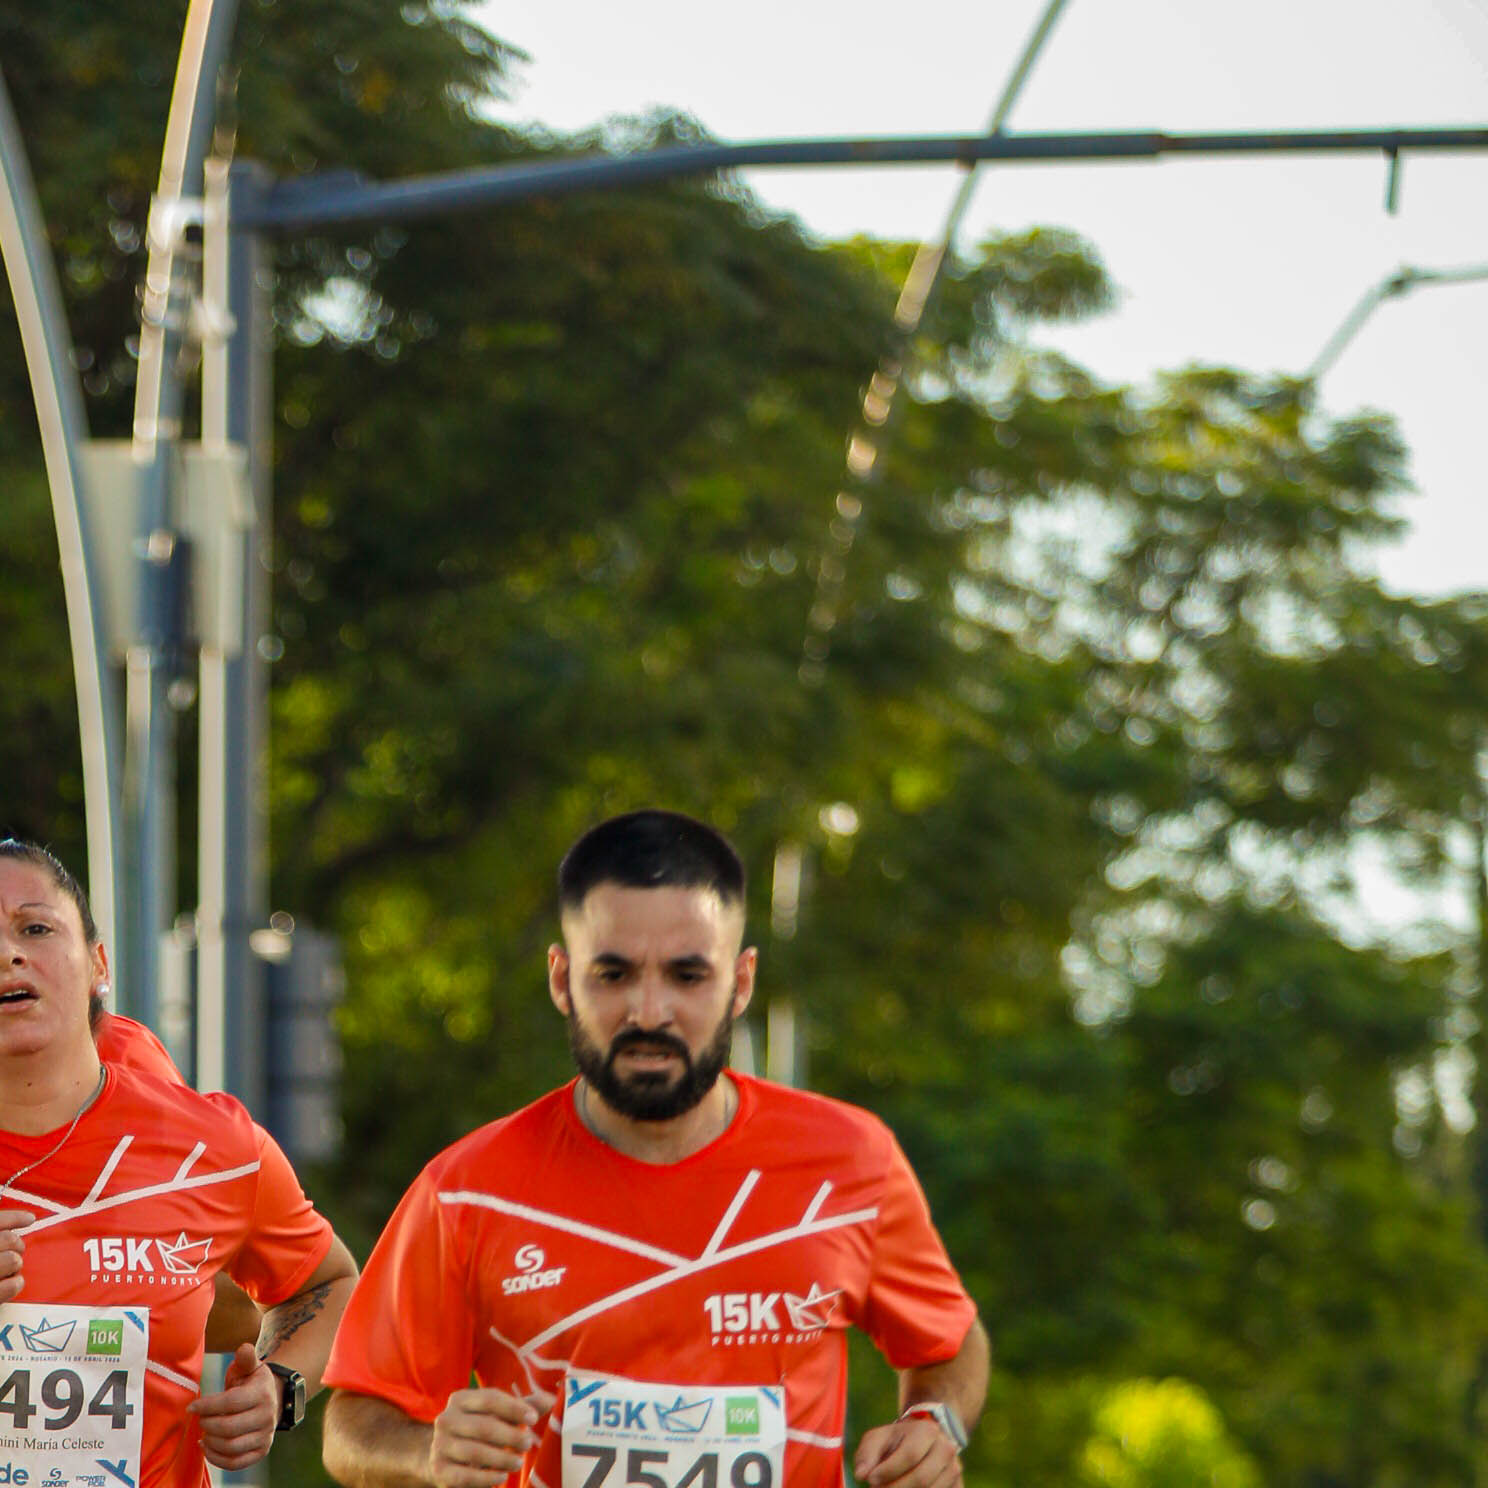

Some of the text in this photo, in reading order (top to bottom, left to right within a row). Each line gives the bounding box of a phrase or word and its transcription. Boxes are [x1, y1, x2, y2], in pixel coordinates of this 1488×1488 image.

[83, 1237, 154, 1272] 15K
[90, 1274, 154, 1284] PUERTO
[704, 1292, 781, 1333] 15K
[92, 1329, 119, 1345] 10K
[712, 1333, 780, 1346] PUERTO
[589, 1398, 646, 1430] 15K
[729, 1407, 756, 1424] 10K
[23, 1437, 58, 1450] María
[62, 1437, 105, 1450] Celeste
